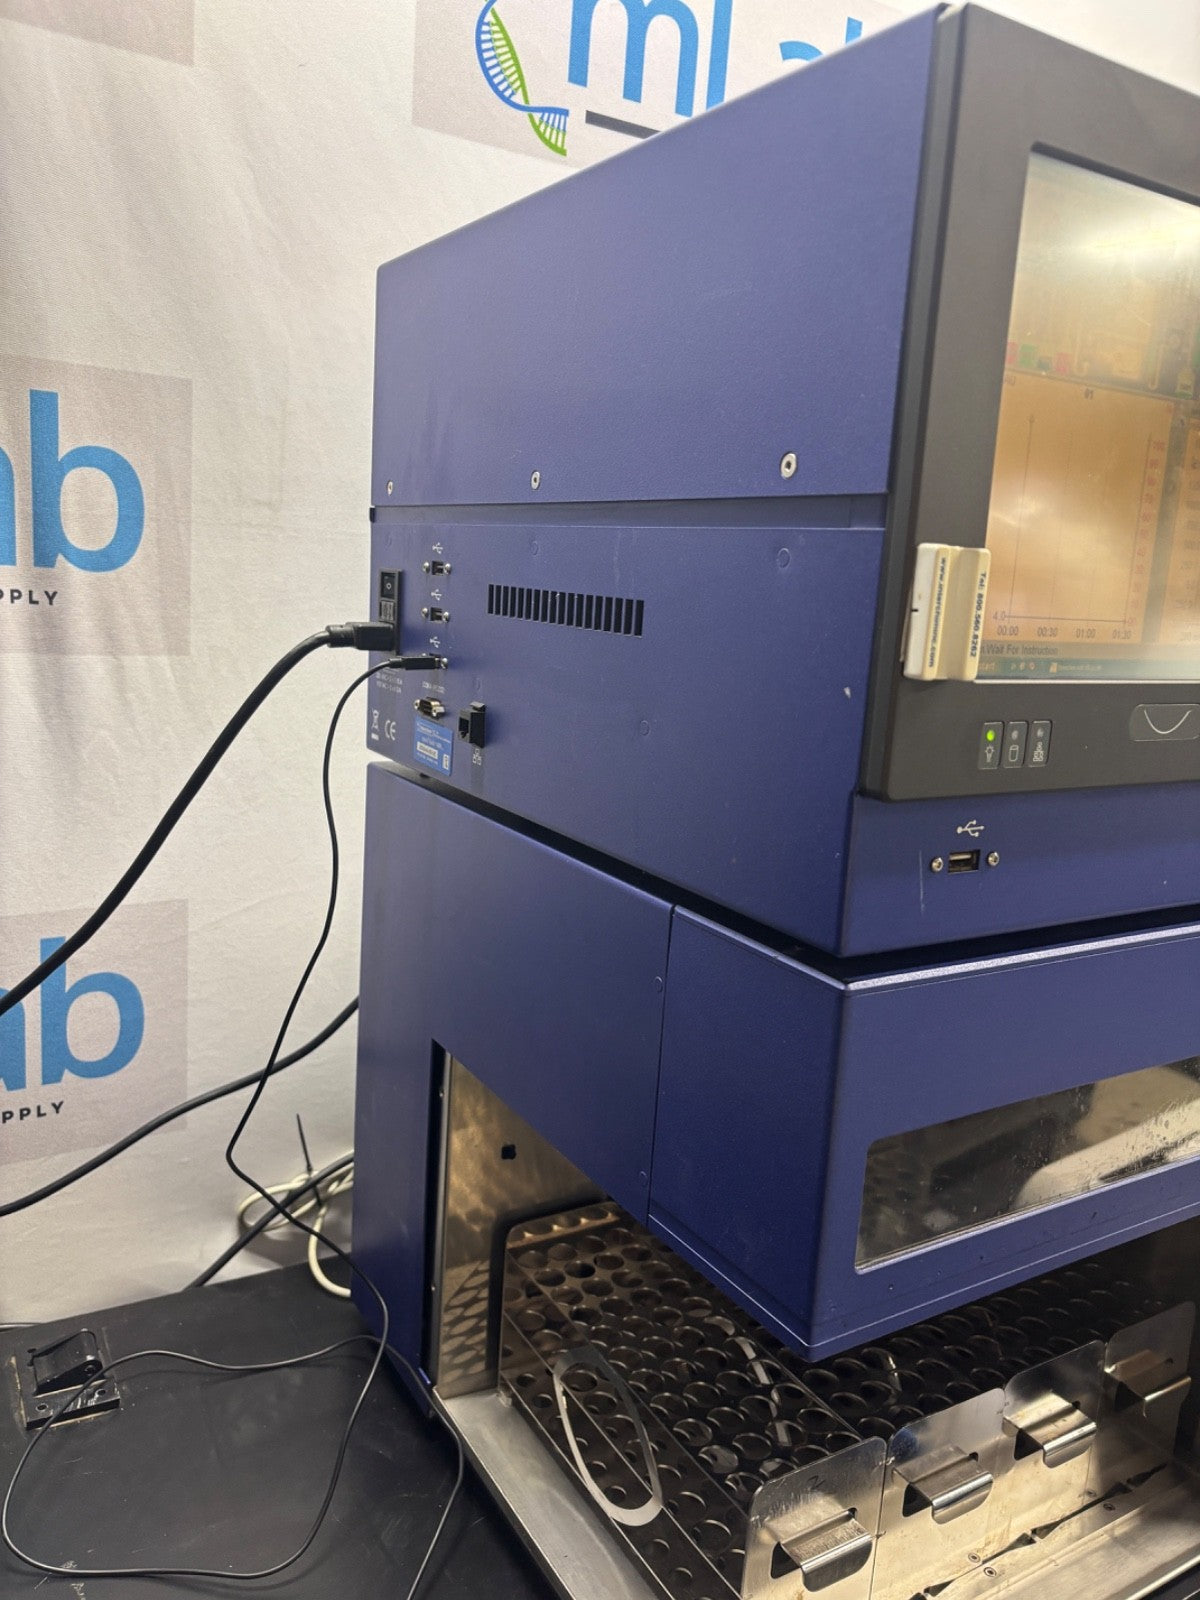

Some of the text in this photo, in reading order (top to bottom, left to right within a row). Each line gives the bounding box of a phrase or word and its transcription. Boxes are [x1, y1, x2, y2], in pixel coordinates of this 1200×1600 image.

[979, 572, 987, 590] Tel:
[0, 588, 58, 606] PLY
[997, 624, 1132, 640] 00:00 00:30 01:00 01:30
[987, 644, 1004, 655] Wait
[1007, 643, 1019, 655] For
[1021, 644, 1058, 656] Instruction
